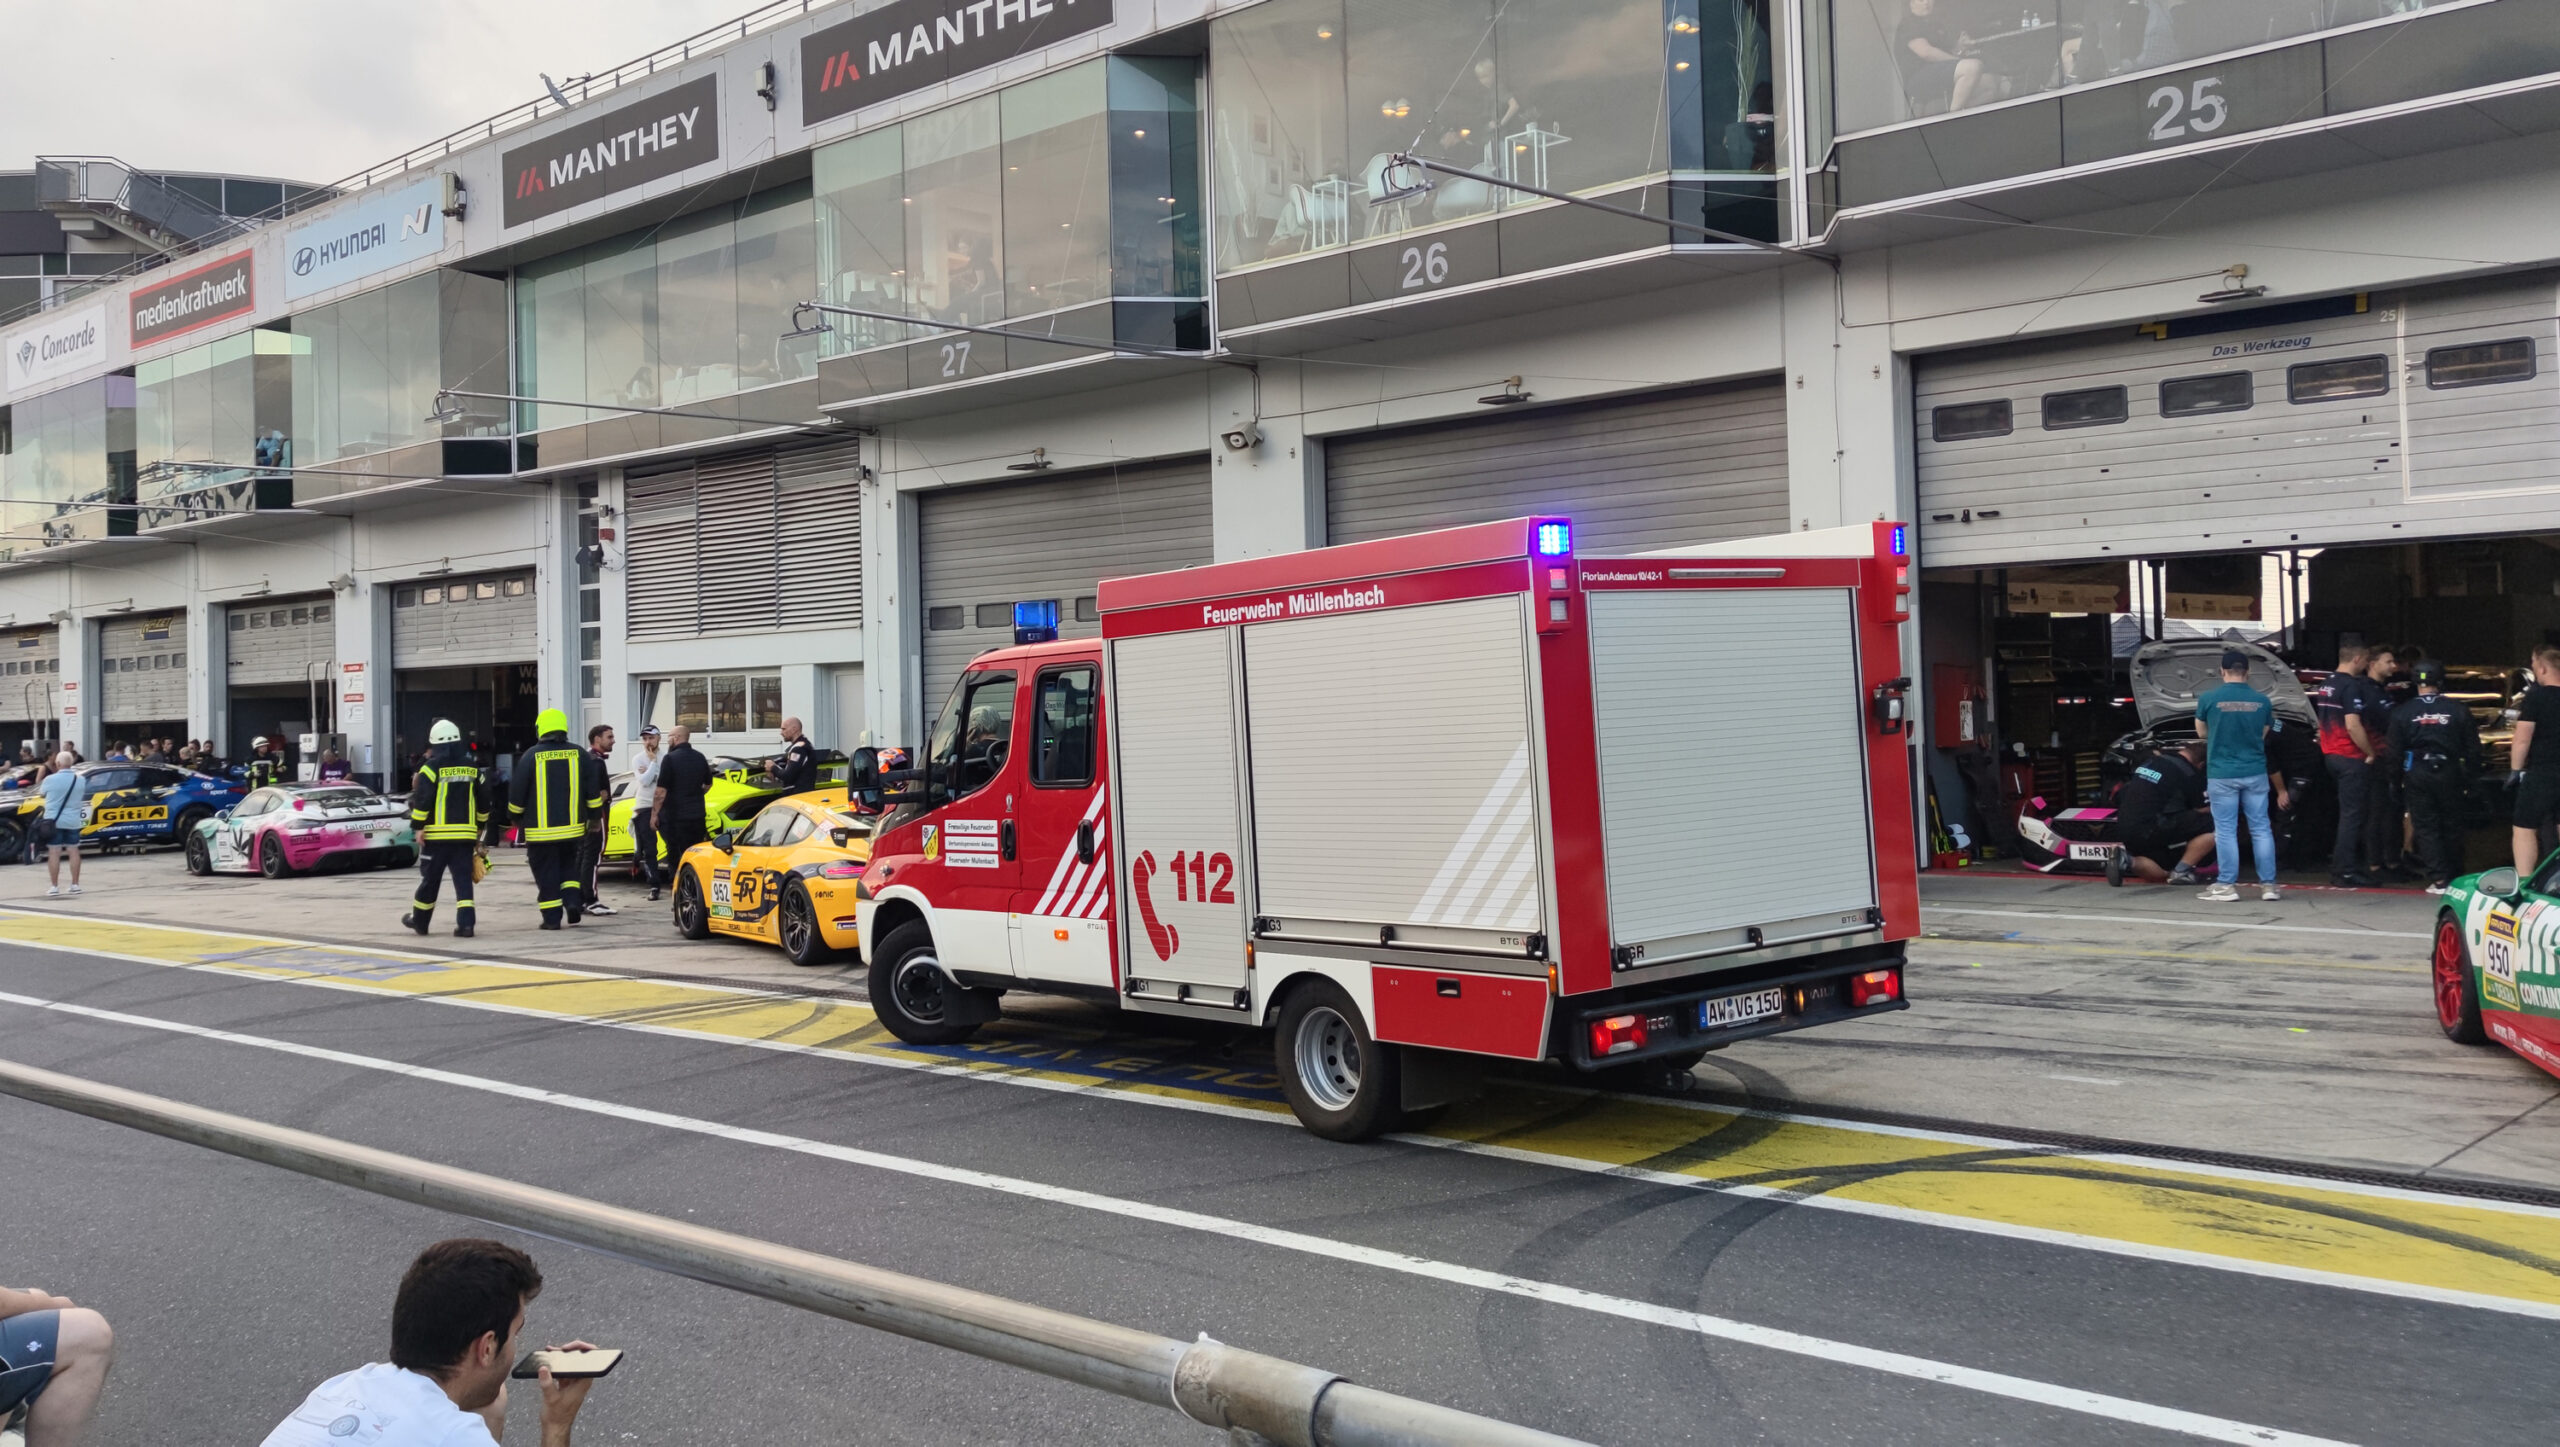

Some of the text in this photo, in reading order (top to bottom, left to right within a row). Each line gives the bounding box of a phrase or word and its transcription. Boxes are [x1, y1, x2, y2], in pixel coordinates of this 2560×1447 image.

[868, 0, 1076, 75] MANTH
[2147, 75, 2228, 142] 25
[550, 105, 700, 188] MANTHEY
[320, 222, 386, 266] HYUNDAI
[1402, 241, 1449, 289] 26
[136, 268, 247, 331] medienkraftwerk
[2380, 310, 2397, 323] 25
[41, 319, 95, 361] Concorde
[2212, 336, 2312, 357] Das Werkzeug
[941, 341, 971, 377] 27
[1203, 584, 1385, 624] Feuerwehr Müllenbach
[440, 767, 477, 777] FEUERWEHR
[536, 751, 578, 761] FEUERWEHR
[102, 810, 142, 821] Giti
[713, 883, 730, 903] 952
[1170, 850, 1235, 904] 112
[1268, 919, 1282, 932] G3
[1500, 937, 1520, 946] BTG
[2488, 940, 2510, 978] 950
[1138, 980, 1150, 992] G1
[1708, 1001, 1727, 1024] AW
[1735, 995, 1754, 1018] VG
[1756, 990, 1781, 1015] 150
